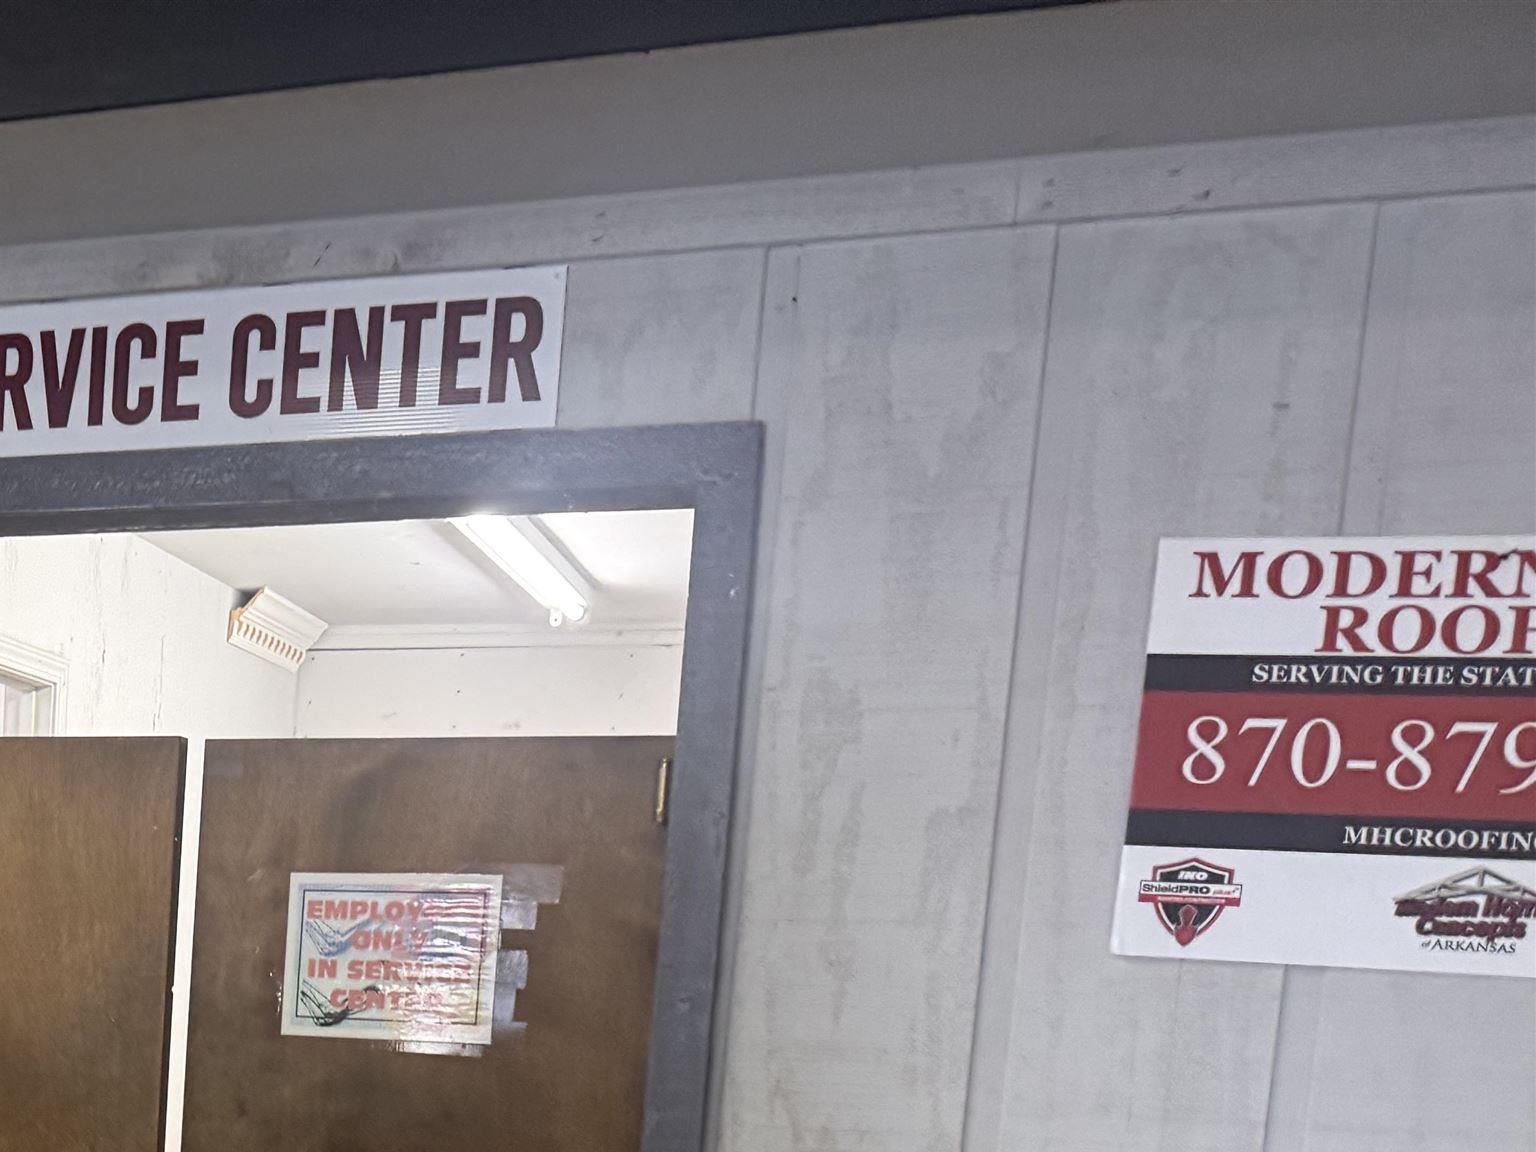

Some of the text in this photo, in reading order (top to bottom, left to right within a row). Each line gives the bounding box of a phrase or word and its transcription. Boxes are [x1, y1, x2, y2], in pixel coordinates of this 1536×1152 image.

[227, 296, 544, 420] CENTER
[1251, 663, 1384, 685] SERVING
[1390, 665, 1454, 686] THE
[1342, 826, 1536, 852] MHCROOFIN
[1177, 870, 1209, 881] IKO
[1142, 883, 1211, 895] ShieldPRO
[306, 899, 481, 922] EMPLOY
[1431, 938, 1517, 954] ARKANSAS
[307, 958, 338, 979] IN
